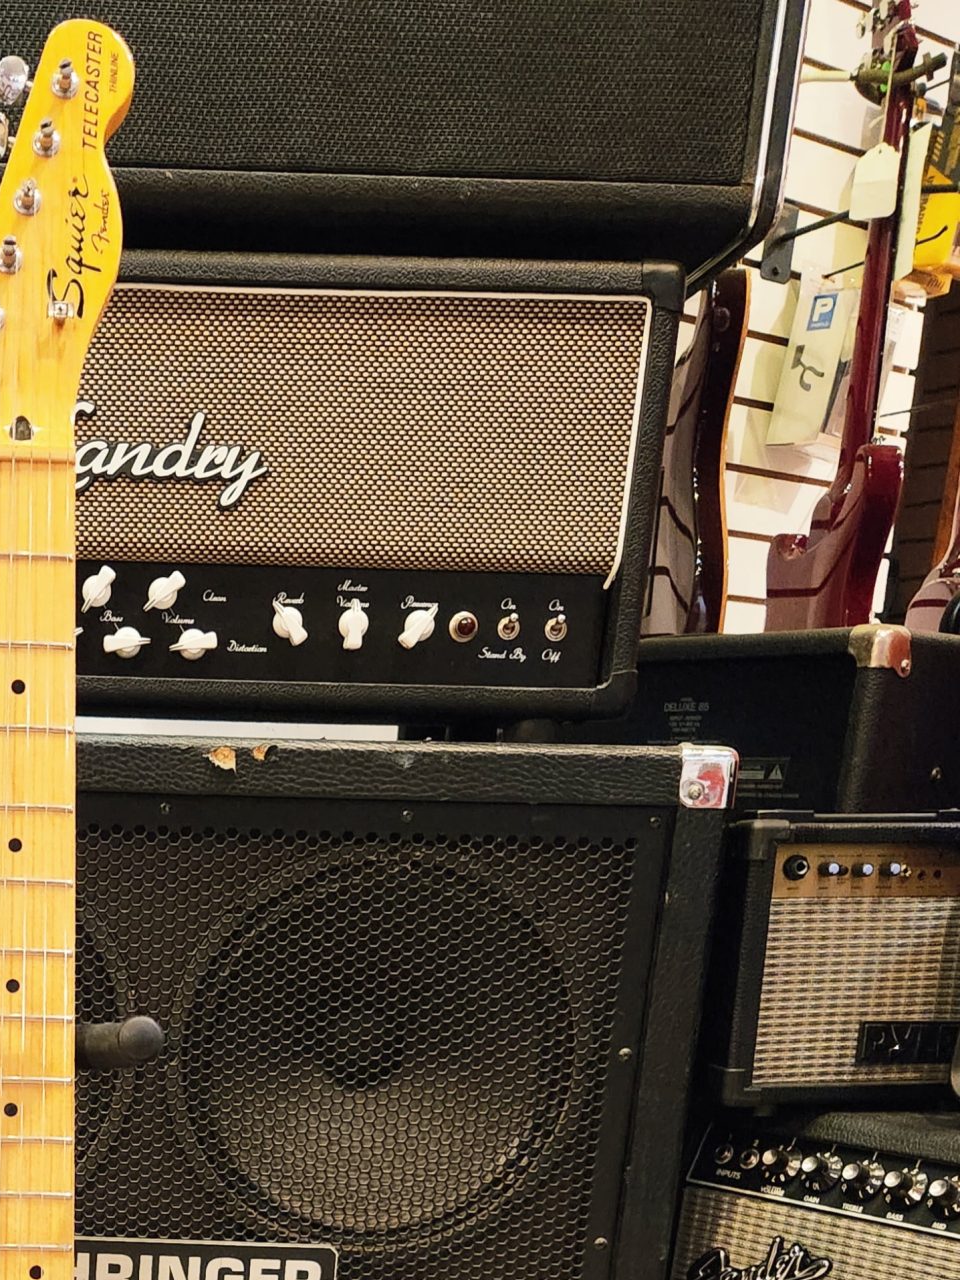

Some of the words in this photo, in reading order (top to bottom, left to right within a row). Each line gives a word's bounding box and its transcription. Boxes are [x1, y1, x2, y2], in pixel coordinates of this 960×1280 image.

[109, 50, 119, 93] THINLINE
[82, 30, 103, 150] TELECASTER
[47, 174, 102, 319] Squier
[336, 595, 370, 608] Vome
[500, 597, 517, 610] On
[548, 599, 565, 612] On
[477, 646, 508, 659] Stand
[508, 647, 527, 662] By
[541, 648, 561, 663] Off
[715, 1168, 742, 1180] INPUTS
